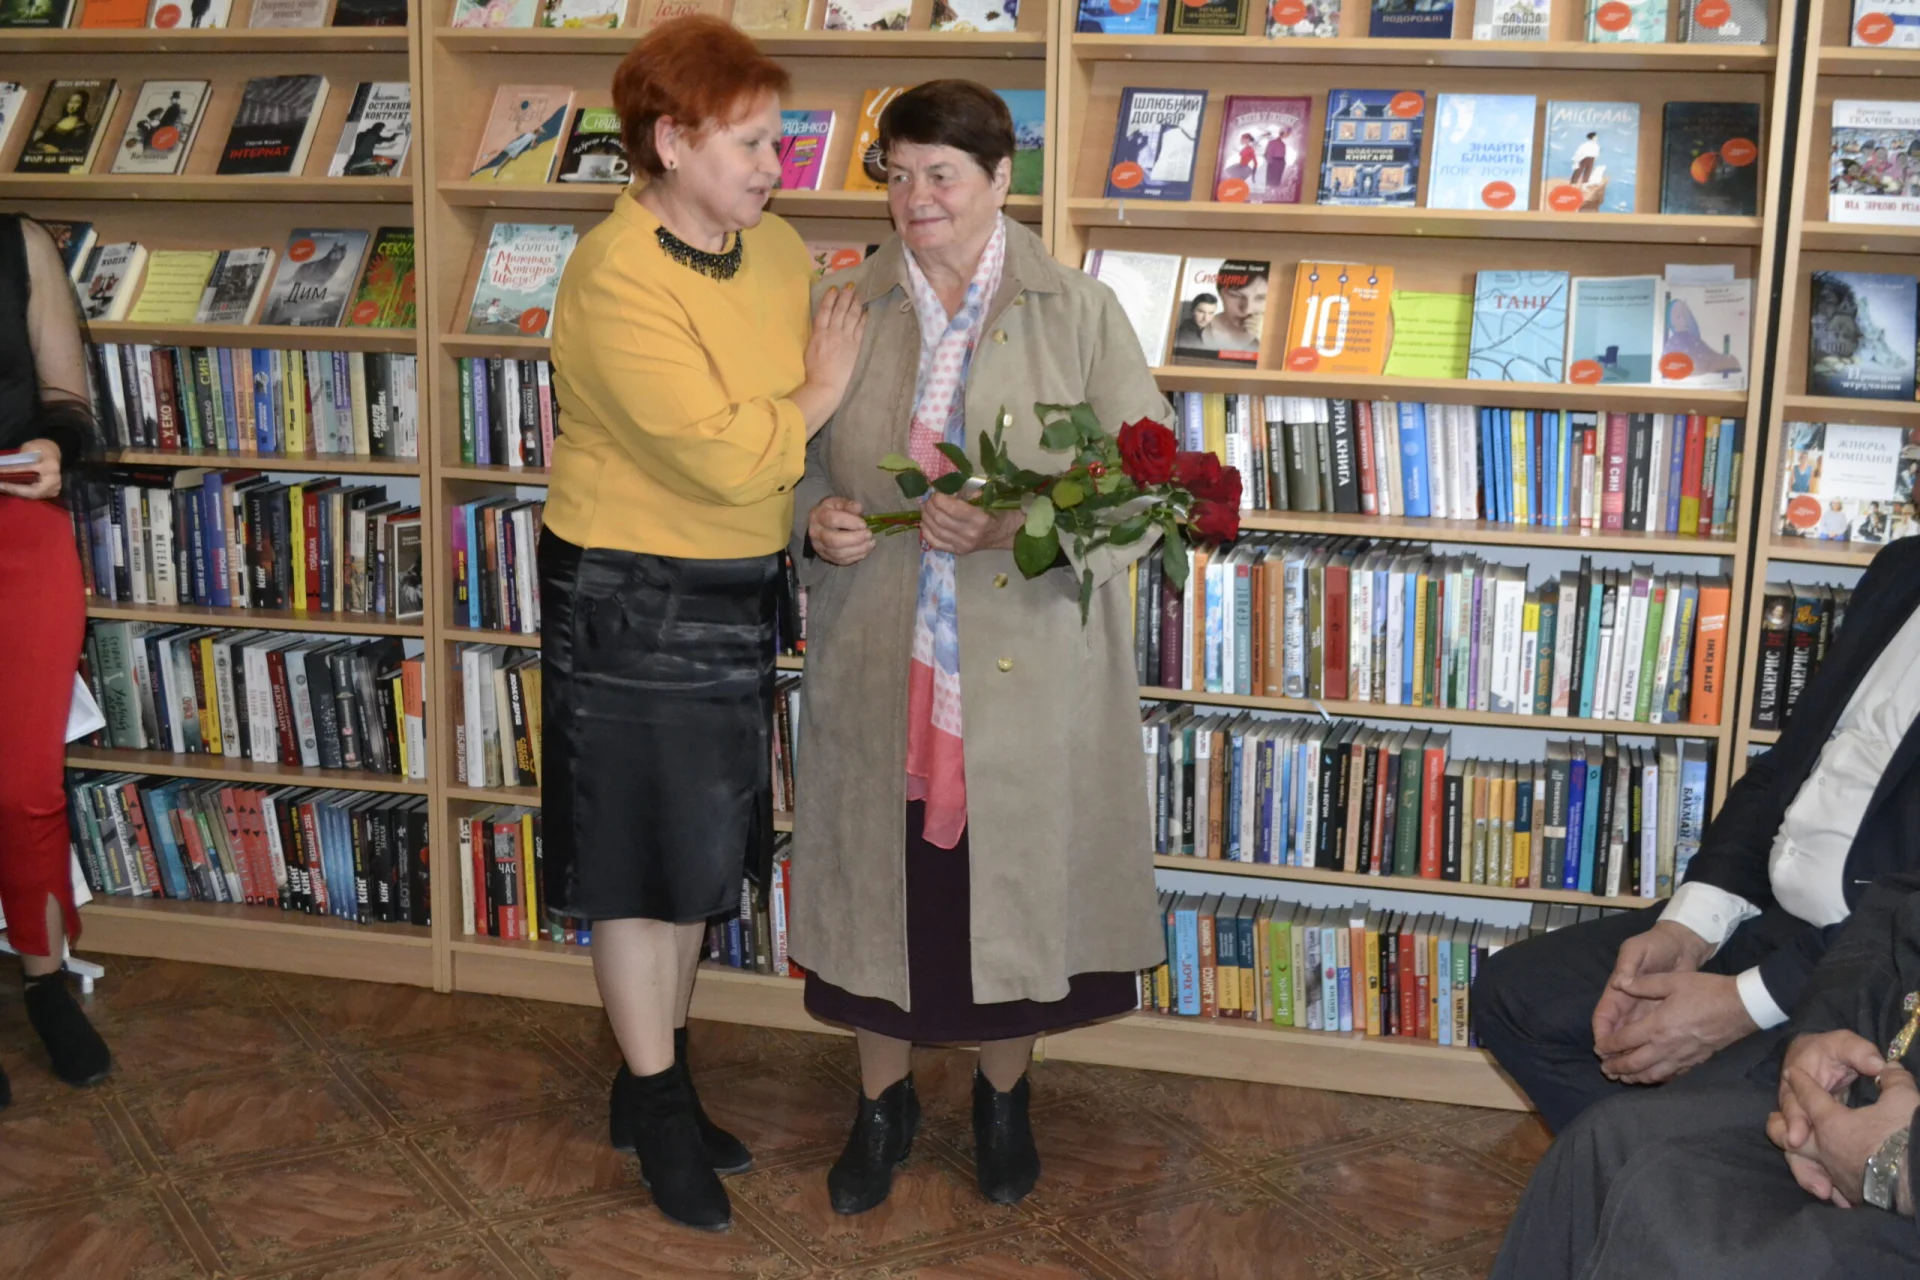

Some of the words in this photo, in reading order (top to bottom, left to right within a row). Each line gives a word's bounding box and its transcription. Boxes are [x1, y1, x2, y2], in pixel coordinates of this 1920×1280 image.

[364, 111, 409, 120] КОНТРАКТ
[1133, 97, 1200, 111] ШЛЮБНИЙ
[1131, 111, 1185, 125] ДОГОВІР
[229, 146, 290, 159] ІНТЕРНАТ
[1461, 153, 1525, 164] БЛАКИТЬ
[1469, 143, 1525, 153] ЗНАЙТИ
[378, 242, 414, 254] СЕКУ
[513, 244, 560, 253] КОЛГАН
[1194, 270, 1248, 290] Спокута
[1301, 296, 1350, 357] 10
[198, 357, 211, 385] СИН
[160, 405, 174, 428] ЕКО
[526, 389, 534, 426] ГЕОГРАФІЯ
[1333, 399, 1346, 436] ОРНА
[371, 403, 384, 438] БІЛИЙ
[1837, 438, 1887, 453] ЖІНОЧА
[1336, 439, 1351, 487] КНИГА
[1828, 450, 1894, 465] КОМПАНІЯ
[1607, 467, 1620, 492] СИН
[155, 534, 168, 582] МЕТЕЛИК
[1703, 639, 1715, 663] ЇХНІ
[1626, 670, 1635, 688] Ренд
[1704, 665, 1713, 693] ДІТИ
[1760, 650, 1781, 709] ЧЕМЕРИС
[273, 684, 287, 732] АНТОЛОГІЯ
[457, 725, 466, 754] ПАГУТЯК
[1678, 788, 1693, 839] БАКМАН
[498, 863, 516, 874] ЧАС
